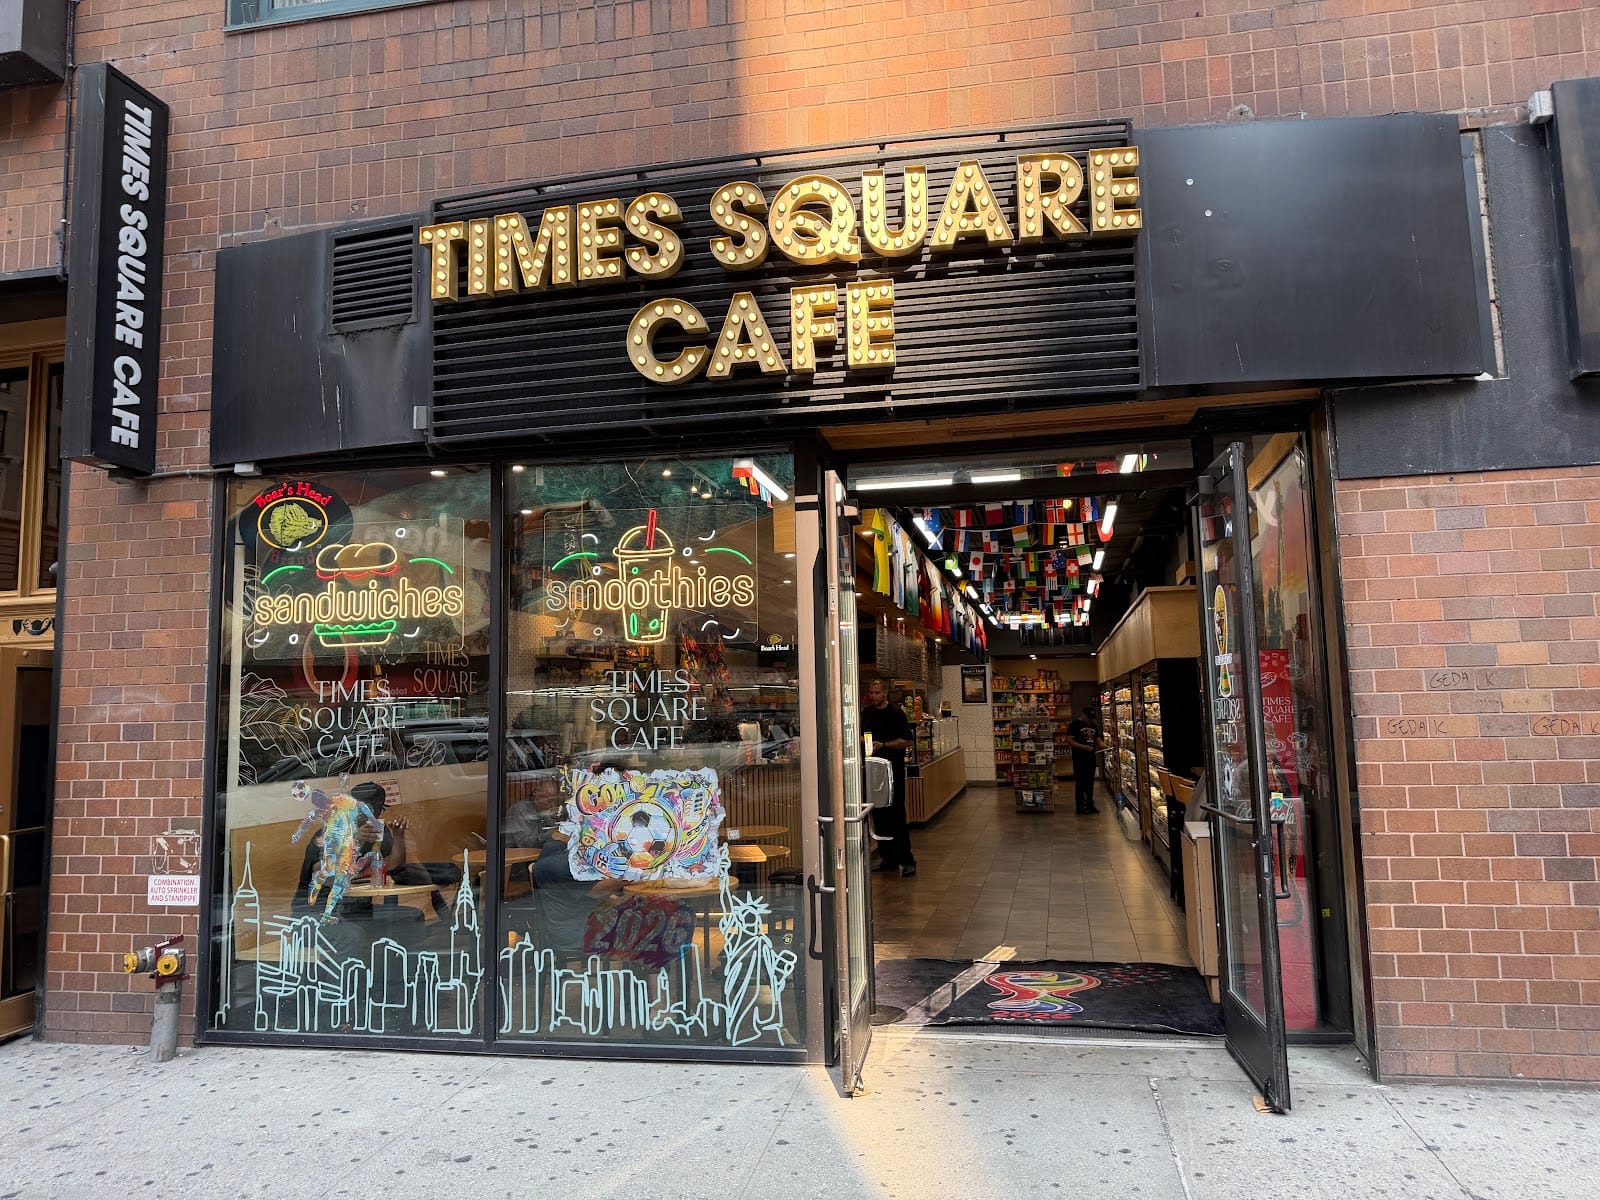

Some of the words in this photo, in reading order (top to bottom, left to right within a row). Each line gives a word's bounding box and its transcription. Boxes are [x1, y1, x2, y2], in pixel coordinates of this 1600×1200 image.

[121, 98, 153, 201] TIMES
[419, 191, 685, 303] TIMES
[709, 145, 1142, 272] SQUARE
[115, 204, 149, 351] SQUARE
[627, 278, 896, 385] CAFE
[110, 355, 142, 450] CAFE
[254, 482, 293, 509] Boar's
[296, 481, 333, 506] Head
[546, 565, 755, 611] smoothies
[254, 577, 463, 626] sandwiches
[423, 640, 470, 667] TIMES
[313, 679, 391, 704] TIMES
[413, 668, 478, 696] SQUARE
[605, 669, 691, 694] TIMES
[1429, 671, 1470, 689] GEDA
[1485, 672, 1496, 686] K
[590, 697, 708, 725] SQUARE
[1262, 696, 1291, 705] TIMES
[1263, 705, 1295, 717] QUARE
[298, 706, 406, 731] SQUARE
[1264, 714, 1292, 723] CAFE
[1532, 716, 1579, 735] GEDA
[316, 733, 386, 758] CAFE
[611, 726, 685, 750] CAFE
[576, 782, 635, 815] GOAL
[150, 886, 166, 894] AUTO
[166, 886, 198, 894] SPRINKLER
[153, 878, 195, 886] COMBINATION
[150, 894, 164, 902] AND
[164, 894, 197, 902] STANDPIPE
[589, 907, 690, 955] 2026
[989, 1010, 1073, 1019] 2026
